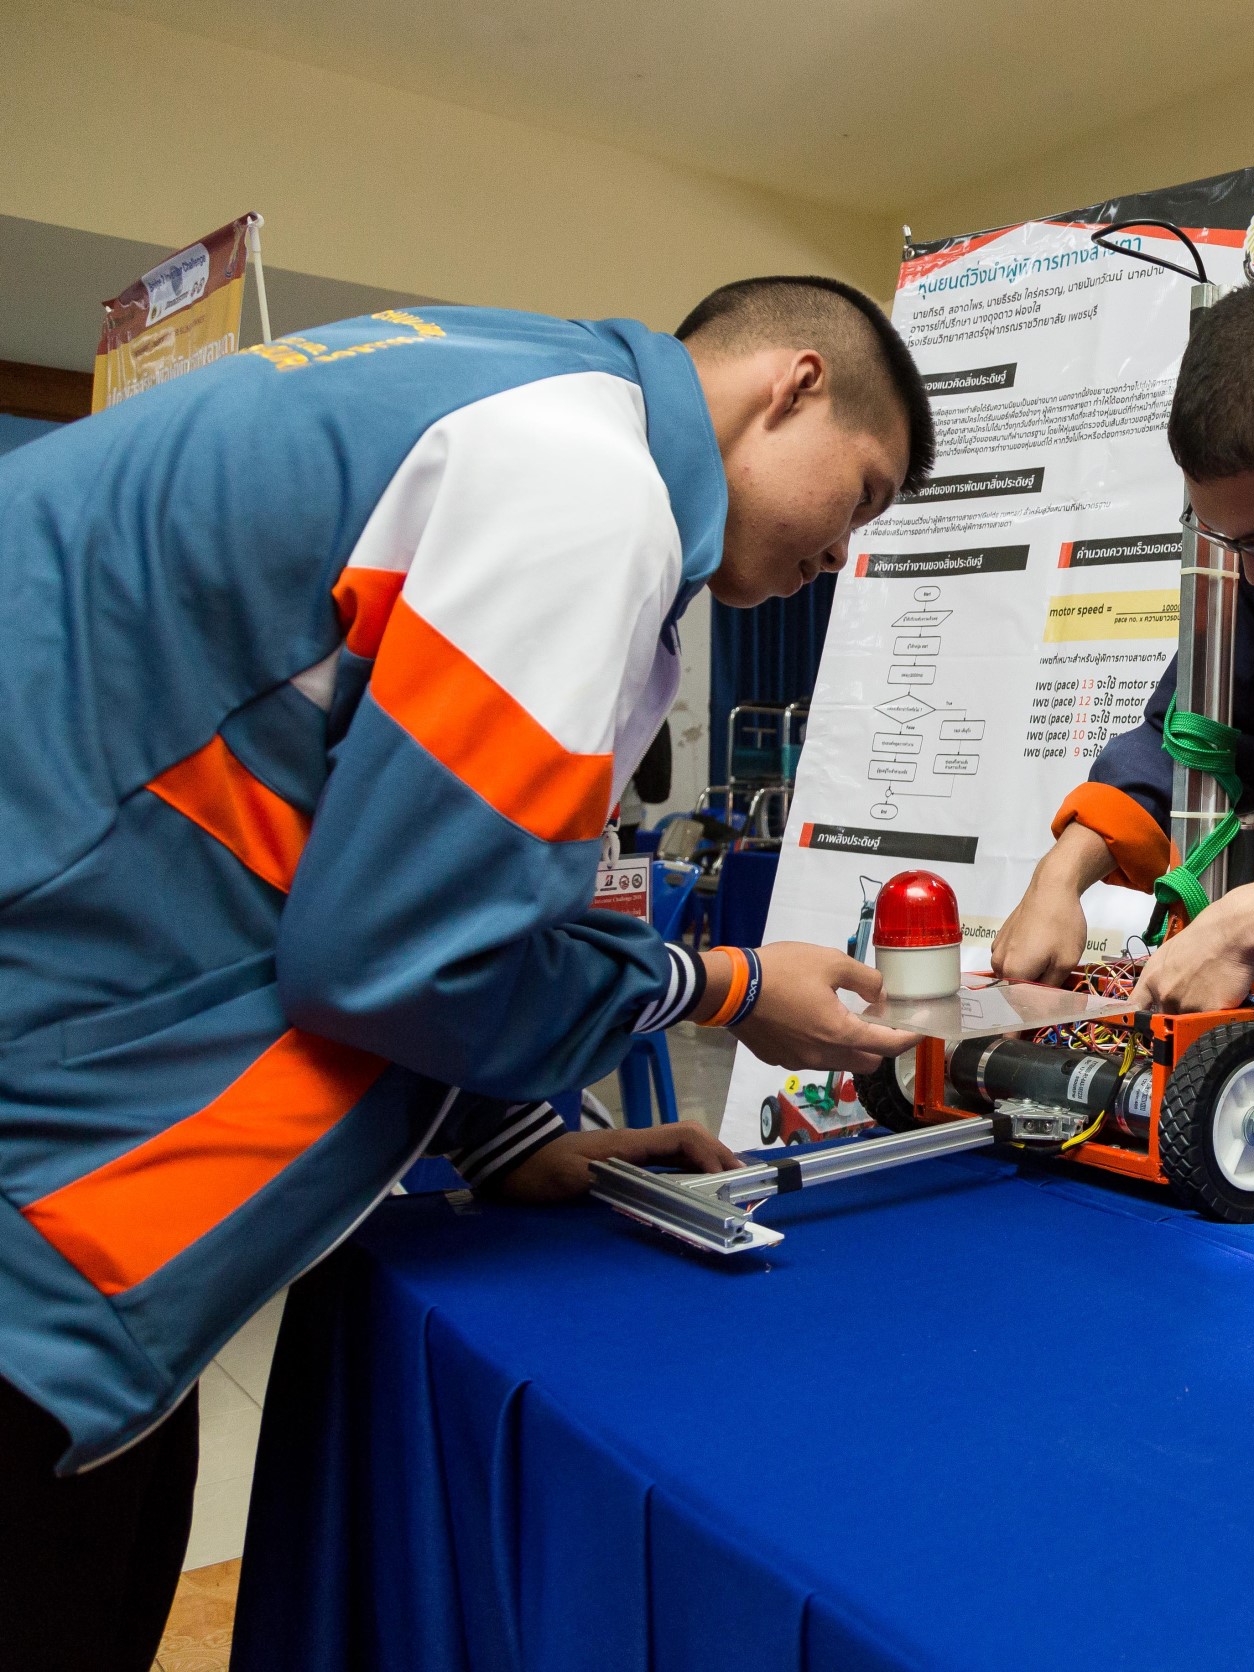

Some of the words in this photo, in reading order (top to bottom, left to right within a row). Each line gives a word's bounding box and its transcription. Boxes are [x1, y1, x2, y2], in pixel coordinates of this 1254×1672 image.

[910, 474, 1036, 498] สงค์ของการพัฒนาสิ่งประดิษฐ์
[874, 554, 984, 572] ผังการทำงานของสิ่งประดิษฐ์
[1047, 606, 1076, 618] motor
[1077, 603, 1105, 618] speed
[1113, 617, 1128, 625] pace
[1054, 679, 1079, 693] (pace)
[1081, 679, 1095, 689] 13
[1096, 675, 1116, 690] จะใช้
[1118, 679, 1148, 689] motor
[1051, 695, 1076, 709] (pace)
[1078, 695, 1091, 706] 12
[1094, 692, 1114, 707] จะใช้
[1115, 696, 1145, 706] motor
[1048, 712, 1073, 725] (pace)
[1075, 713, 1087, 723] 11
[1090, 709, 1110, 724] จะใช้
[1112, 713, 1142, 724] motor
[1045, 729, 1070, 742] (pace)
[1072, 730, 1085, 740] 10
[1087, 726, 1107, 741] จะใช้
[1042, 746, 1067, 760] (pace)
[1073, 746, 1080, 757] 9
[817, 828, 882, 850] ภาพสิ่งประดิษฐ์
[960, 923, 1001, 939] ร้อมตัดสก
[1086, 938, 1108, 952] ยนต์
[789, 1080, 796, 1090] 2
